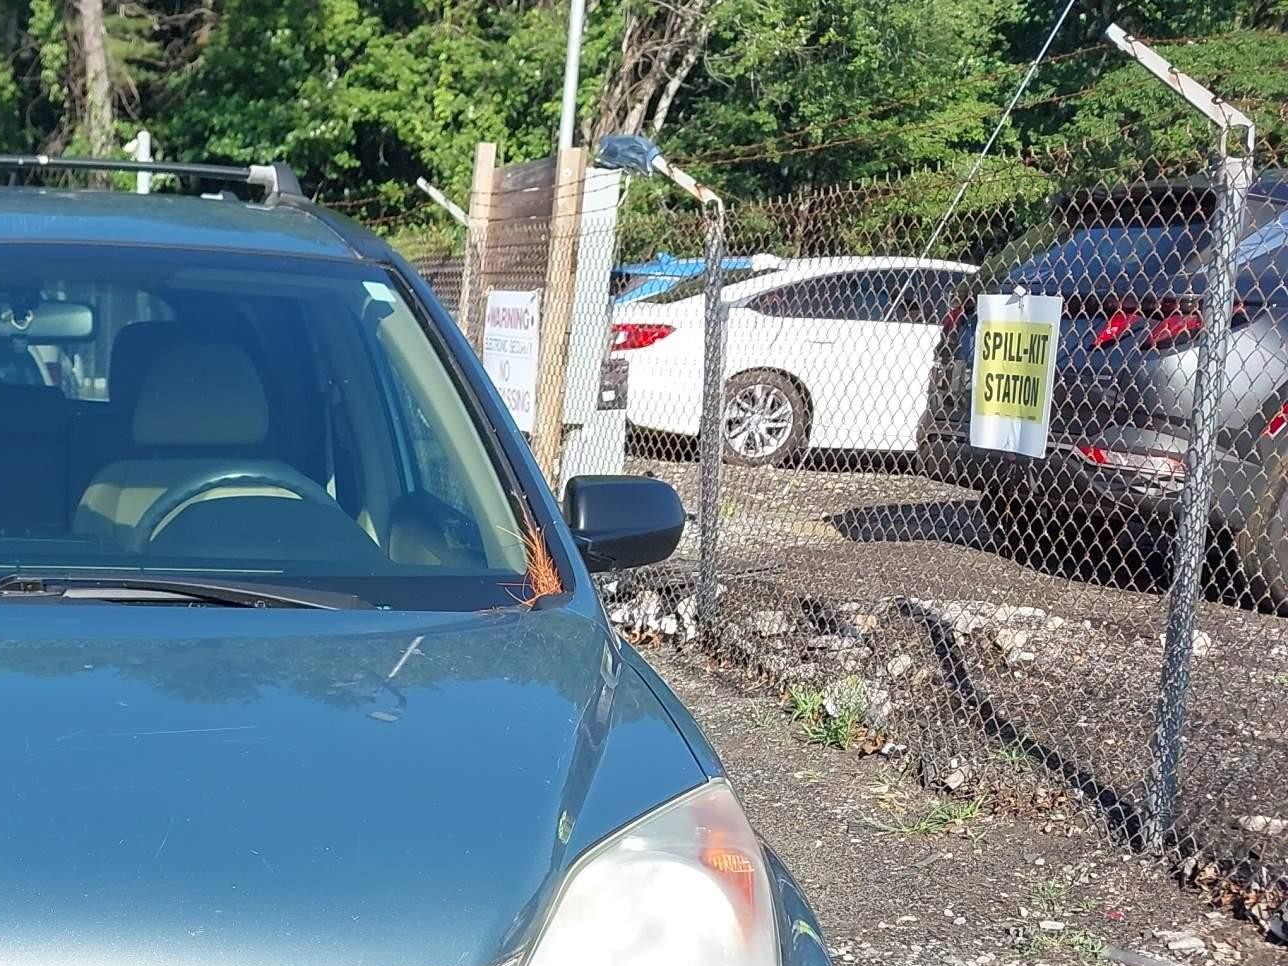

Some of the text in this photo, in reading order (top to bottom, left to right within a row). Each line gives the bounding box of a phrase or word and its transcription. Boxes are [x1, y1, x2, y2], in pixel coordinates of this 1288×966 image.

[489, 306, 530, 331] WARNING
[982, 330, 1049, 365] SPILL-KIT
[983, 372, 1040, 407] STATION
